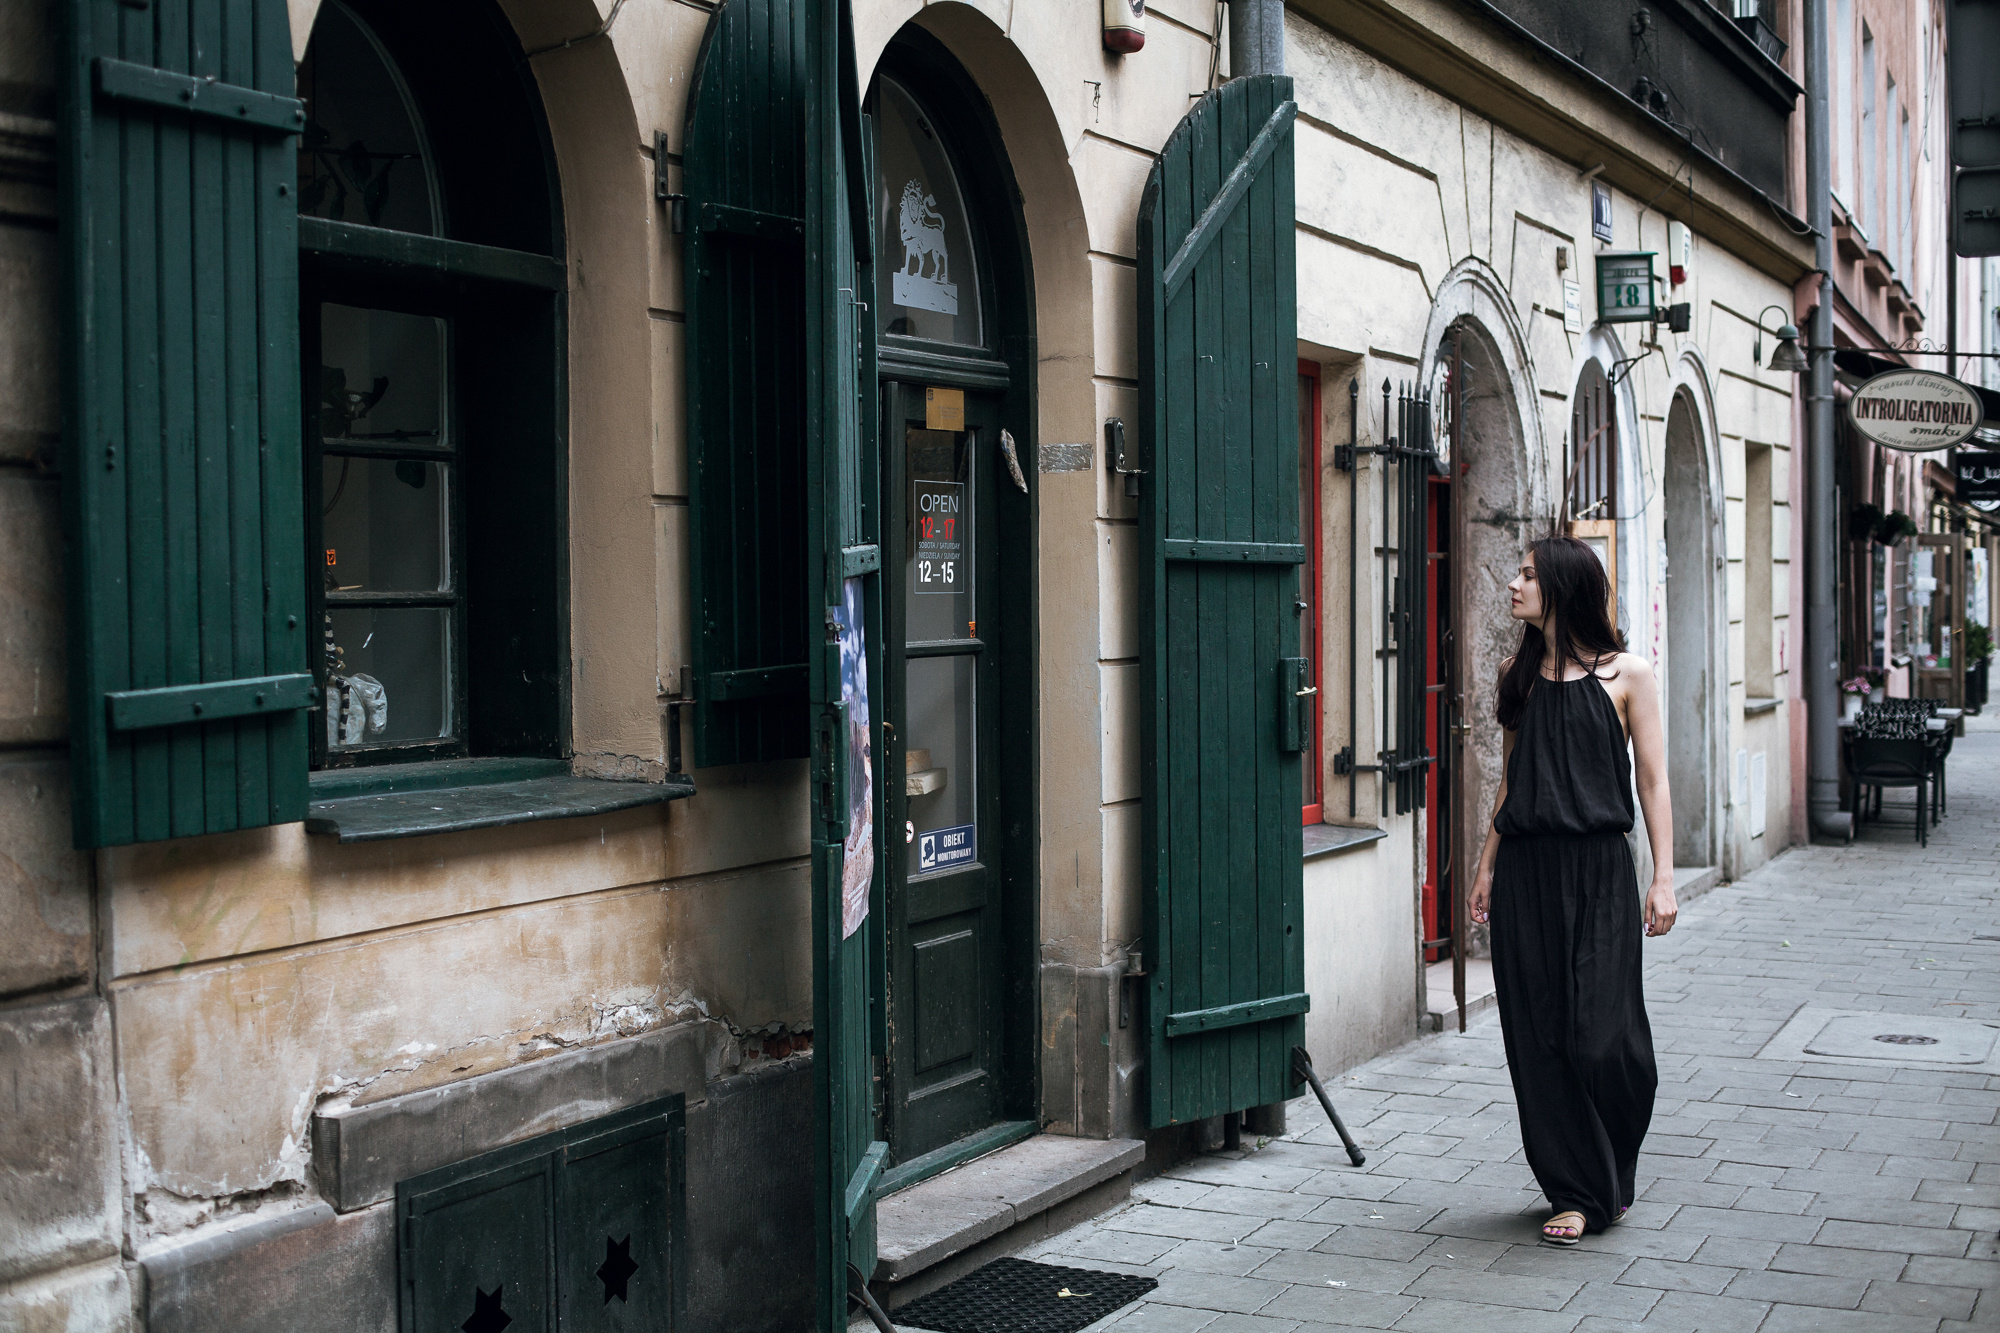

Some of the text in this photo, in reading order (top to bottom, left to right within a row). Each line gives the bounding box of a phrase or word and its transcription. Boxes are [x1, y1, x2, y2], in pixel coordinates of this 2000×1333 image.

[1614, 284, 1640, 307] 18
[1878, 376, 1954, 397] casual dining
[1856, 397, 1973, 425] INTROLIGATORNIA
[1909, 425, 1961, 437] smaku
[920, 493, 958, 513] OPEN
[921, 516, 934, 538] 12
[944, 519, 955, 540] 17
[919, 541, 935, 549] SOBOTA
[940, 542, 960, 550] SATURDAY
[919, 552, 940, 560] NIEDZIELA
[943, 832, 965, 848] OBIEKT
[937, 847, 972, 862] MONITOROWANY
